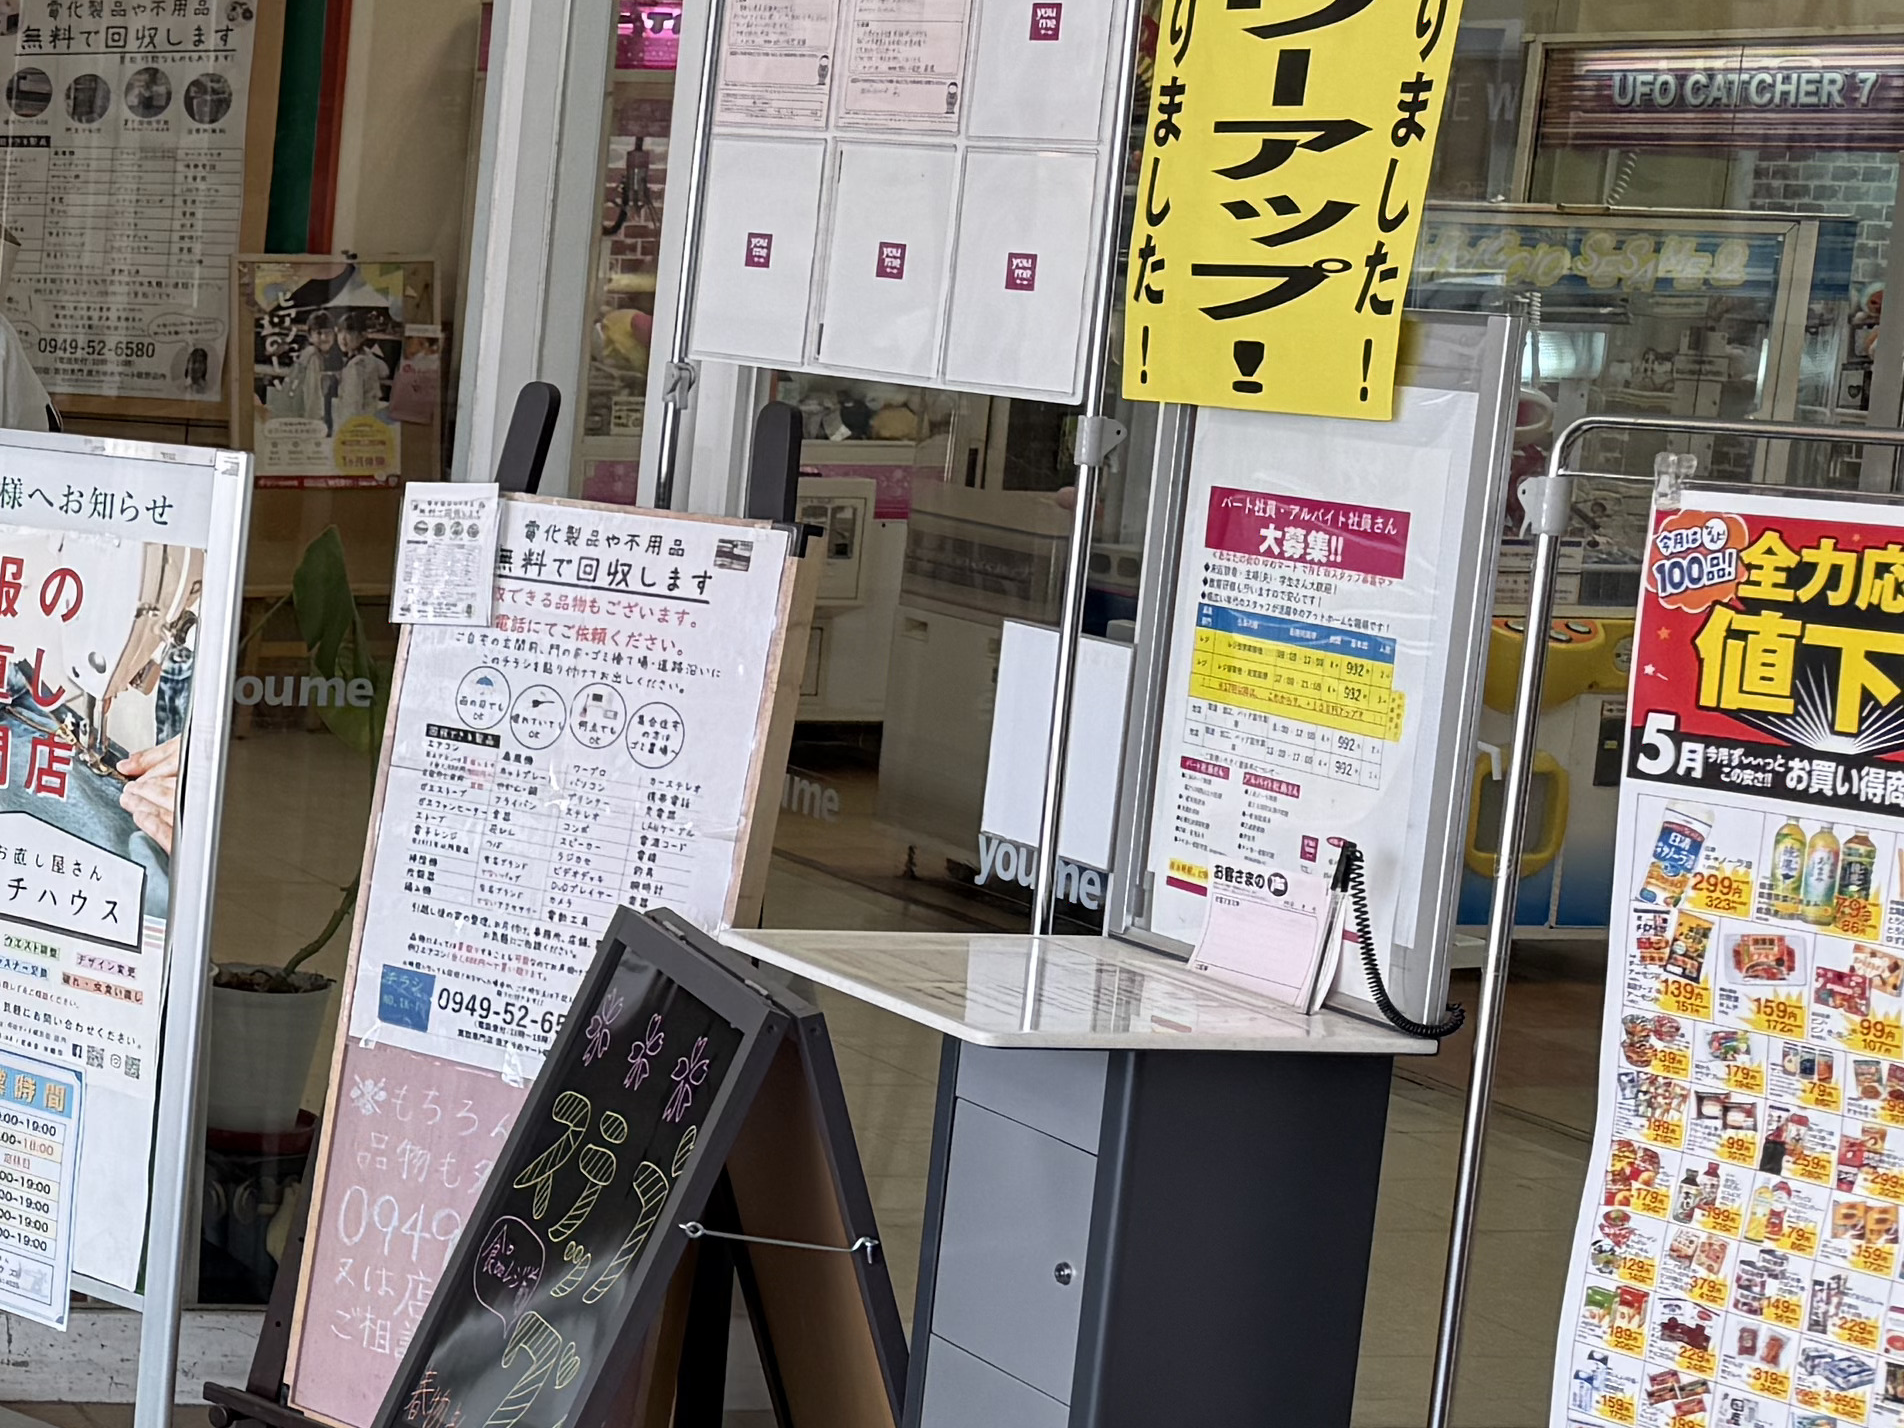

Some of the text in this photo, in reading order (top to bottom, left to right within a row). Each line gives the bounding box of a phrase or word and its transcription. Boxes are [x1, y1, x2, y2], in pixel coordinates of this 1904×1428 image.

[21, 25, 235, 50] 無料で回収します
[1612, 71, 1880, 107] UFO CATCHER 7
[38, 337, 155, 359] 0949-52-6580
[524, 520, 686, 558] 電化製品や不用品
[1695, 606, 1904, 734] 値下
[234, 674, 375, 708] oume
[1637, 712, 1705, 779] 5月
[338, 1185, 462, 1263] 0949
